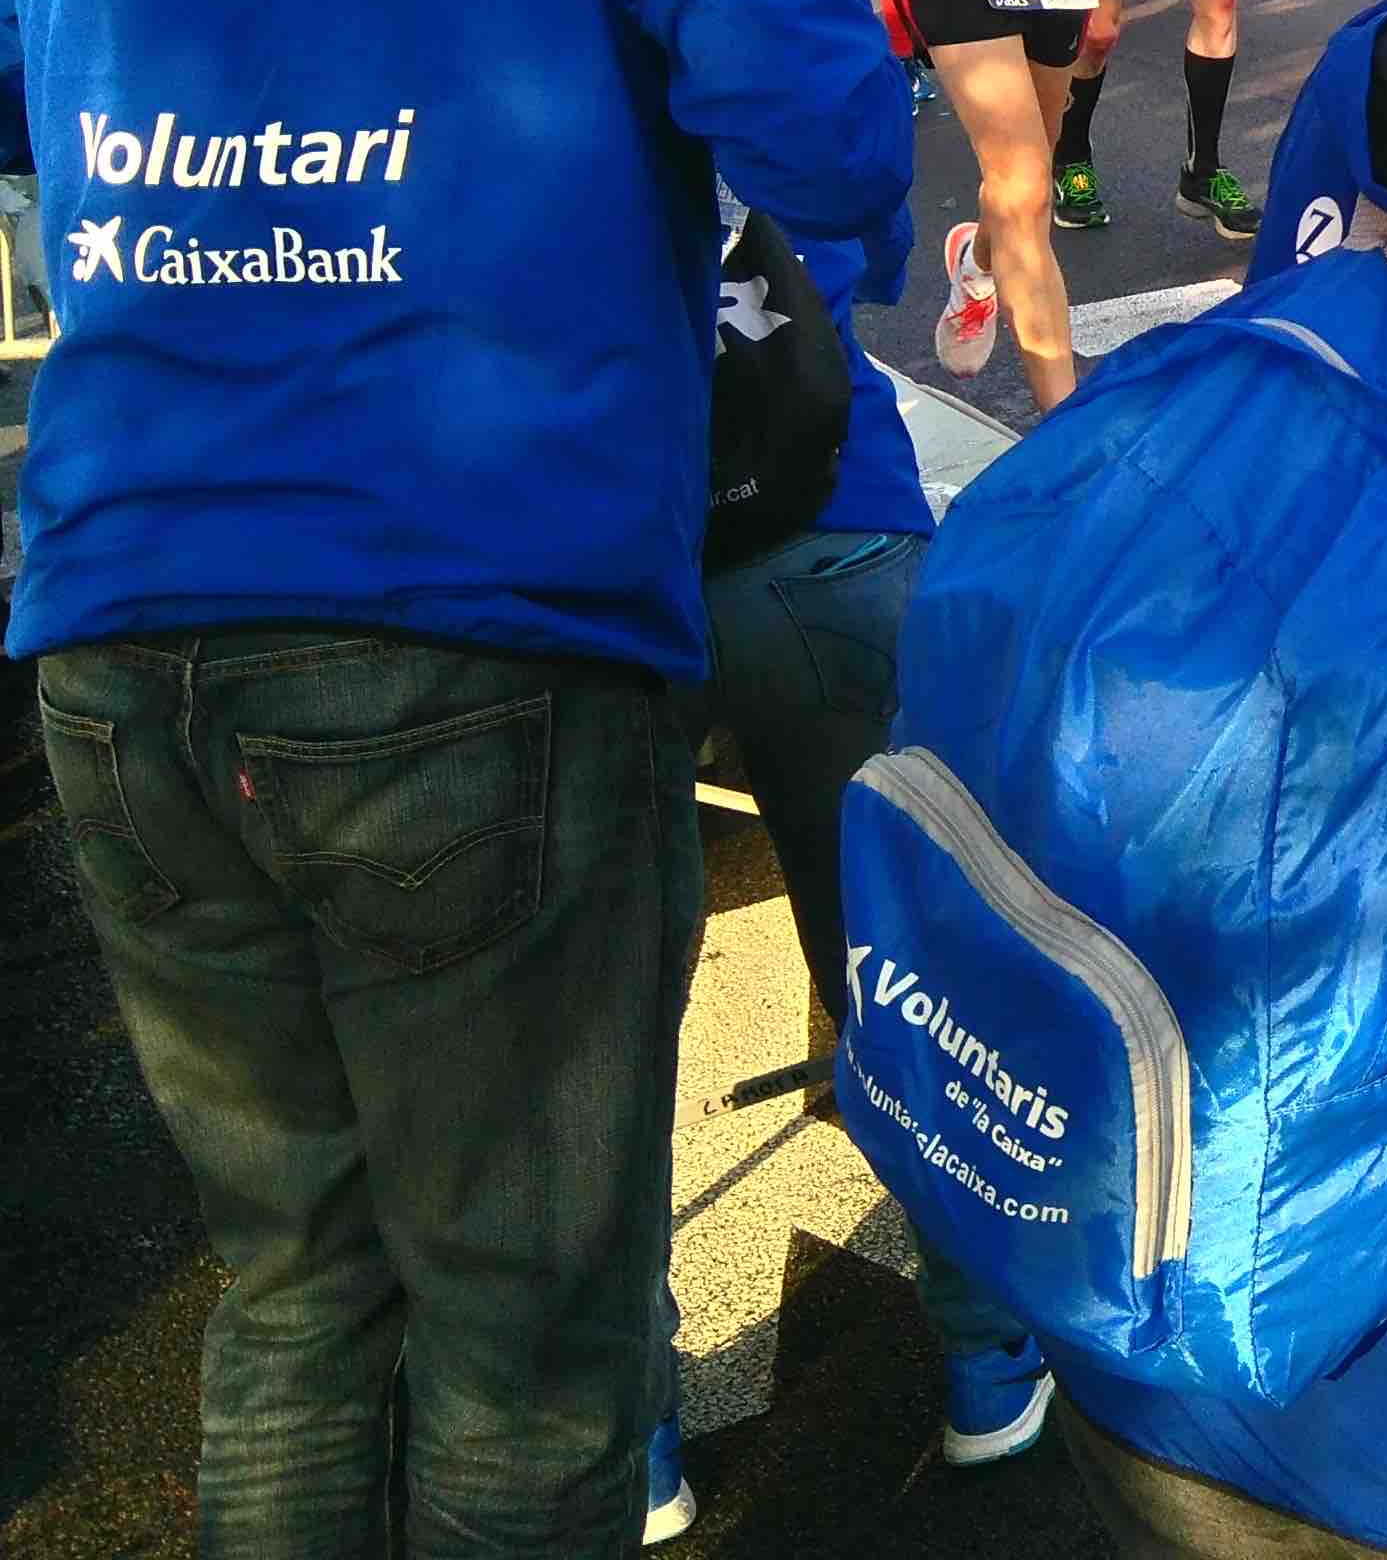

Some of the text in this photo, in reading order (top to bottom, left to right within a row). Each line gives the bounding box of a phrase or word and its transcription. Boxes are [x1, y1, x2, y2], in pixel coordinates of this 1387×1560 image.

[79, 108, 415, 188] Voluntari
[133, 224, 403, 285] CaixaBank
[874, 958, 1071, 1141] Voluntaris
[945, 1079, 970, 1109] de
